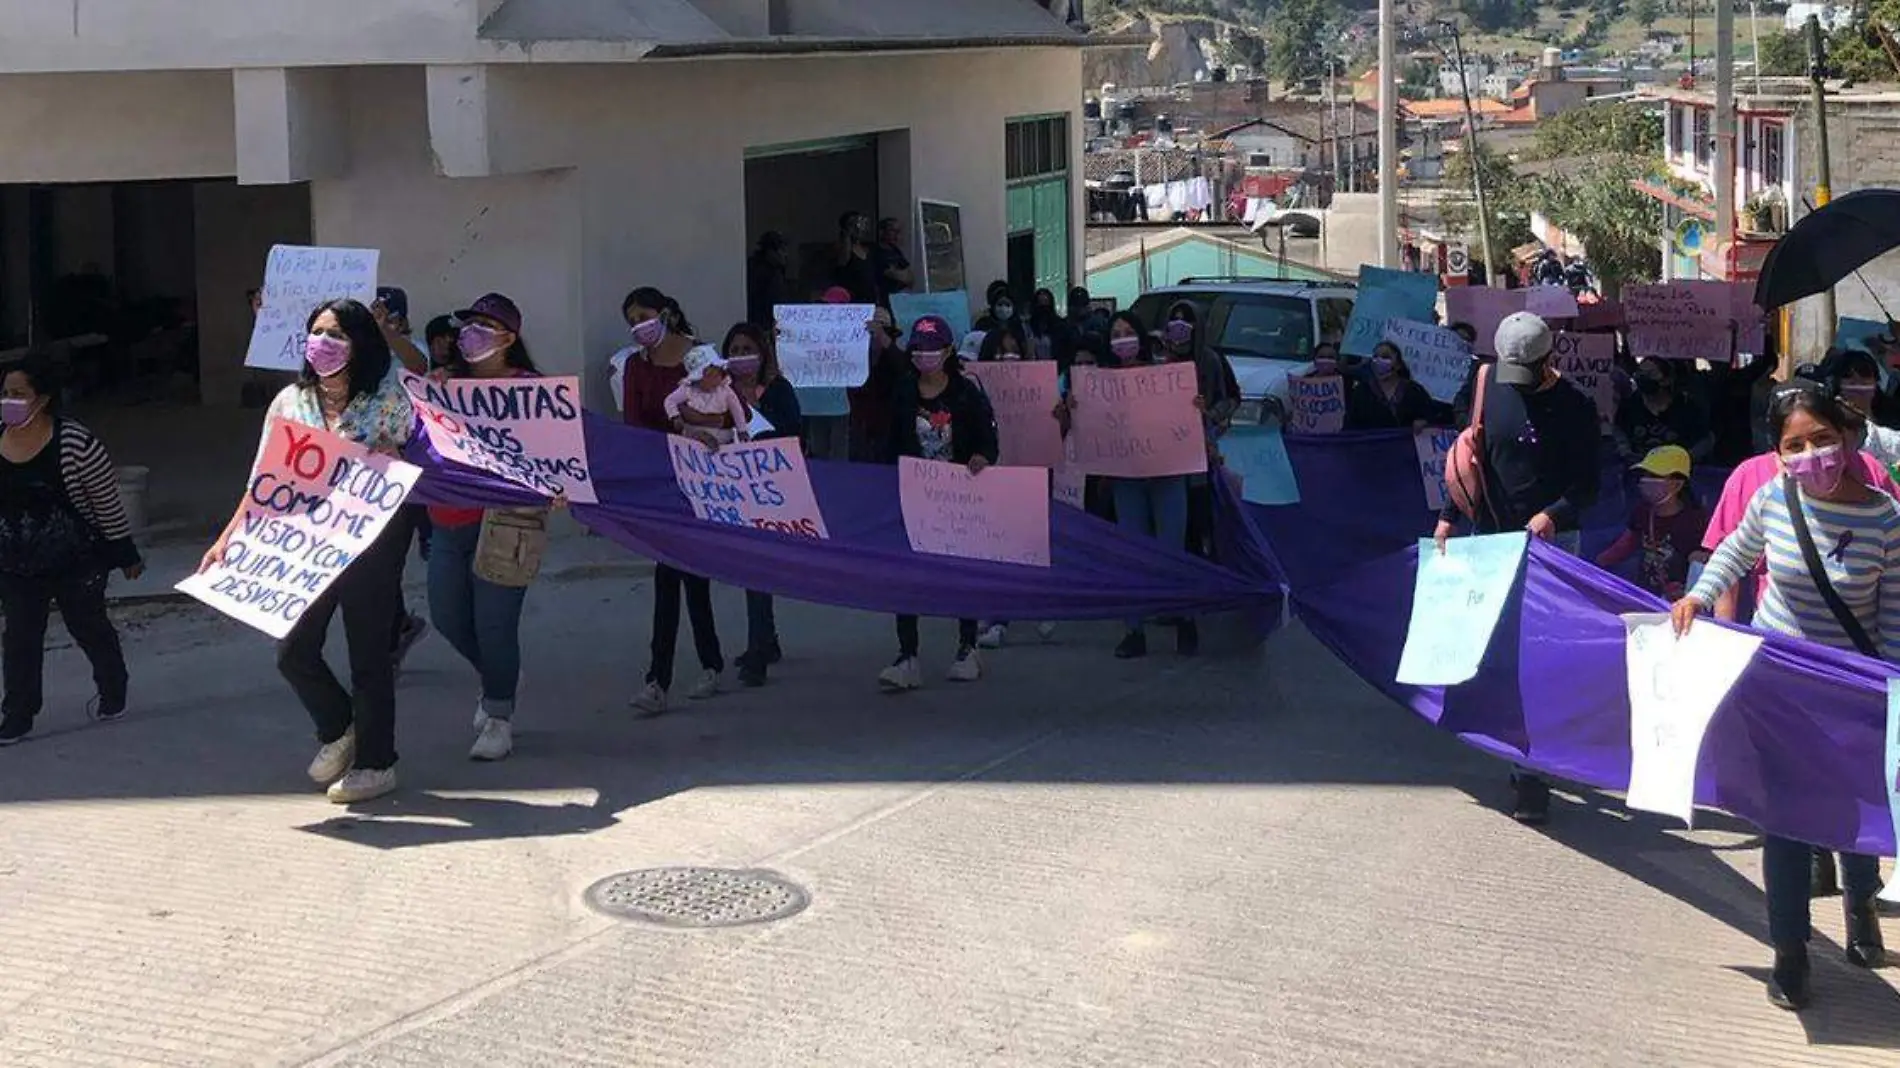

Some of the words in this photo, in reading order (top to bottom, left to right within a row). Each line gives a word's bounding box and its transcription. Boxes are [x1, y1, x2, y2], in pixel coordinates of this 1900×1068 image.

[403, 376, 577, 421] CALLADITAS
[284, 424, 326, 481] YO
[465, 422, 524, 454] NOS
[535, 457, 588, 482] MAS
[674, 444, 793, 481] NUESTRA
[327, 456, 406, 512] DECIDO
[679, 477, 746, 503] LUCHA
[749, 479, 786, 507] ES
[243, 510, 306, 553] VISTO
[331, 509, 375, 540] ME
[750, 516, 822, 540] TODAS
[221, 540, 294, 582] QUIEN
[290, 567, 333, 593] ME
[302, 535, 327, 564] Y
[311, 543, 352, 569] CON
[209, 574, 308, 622] DESVISTO
